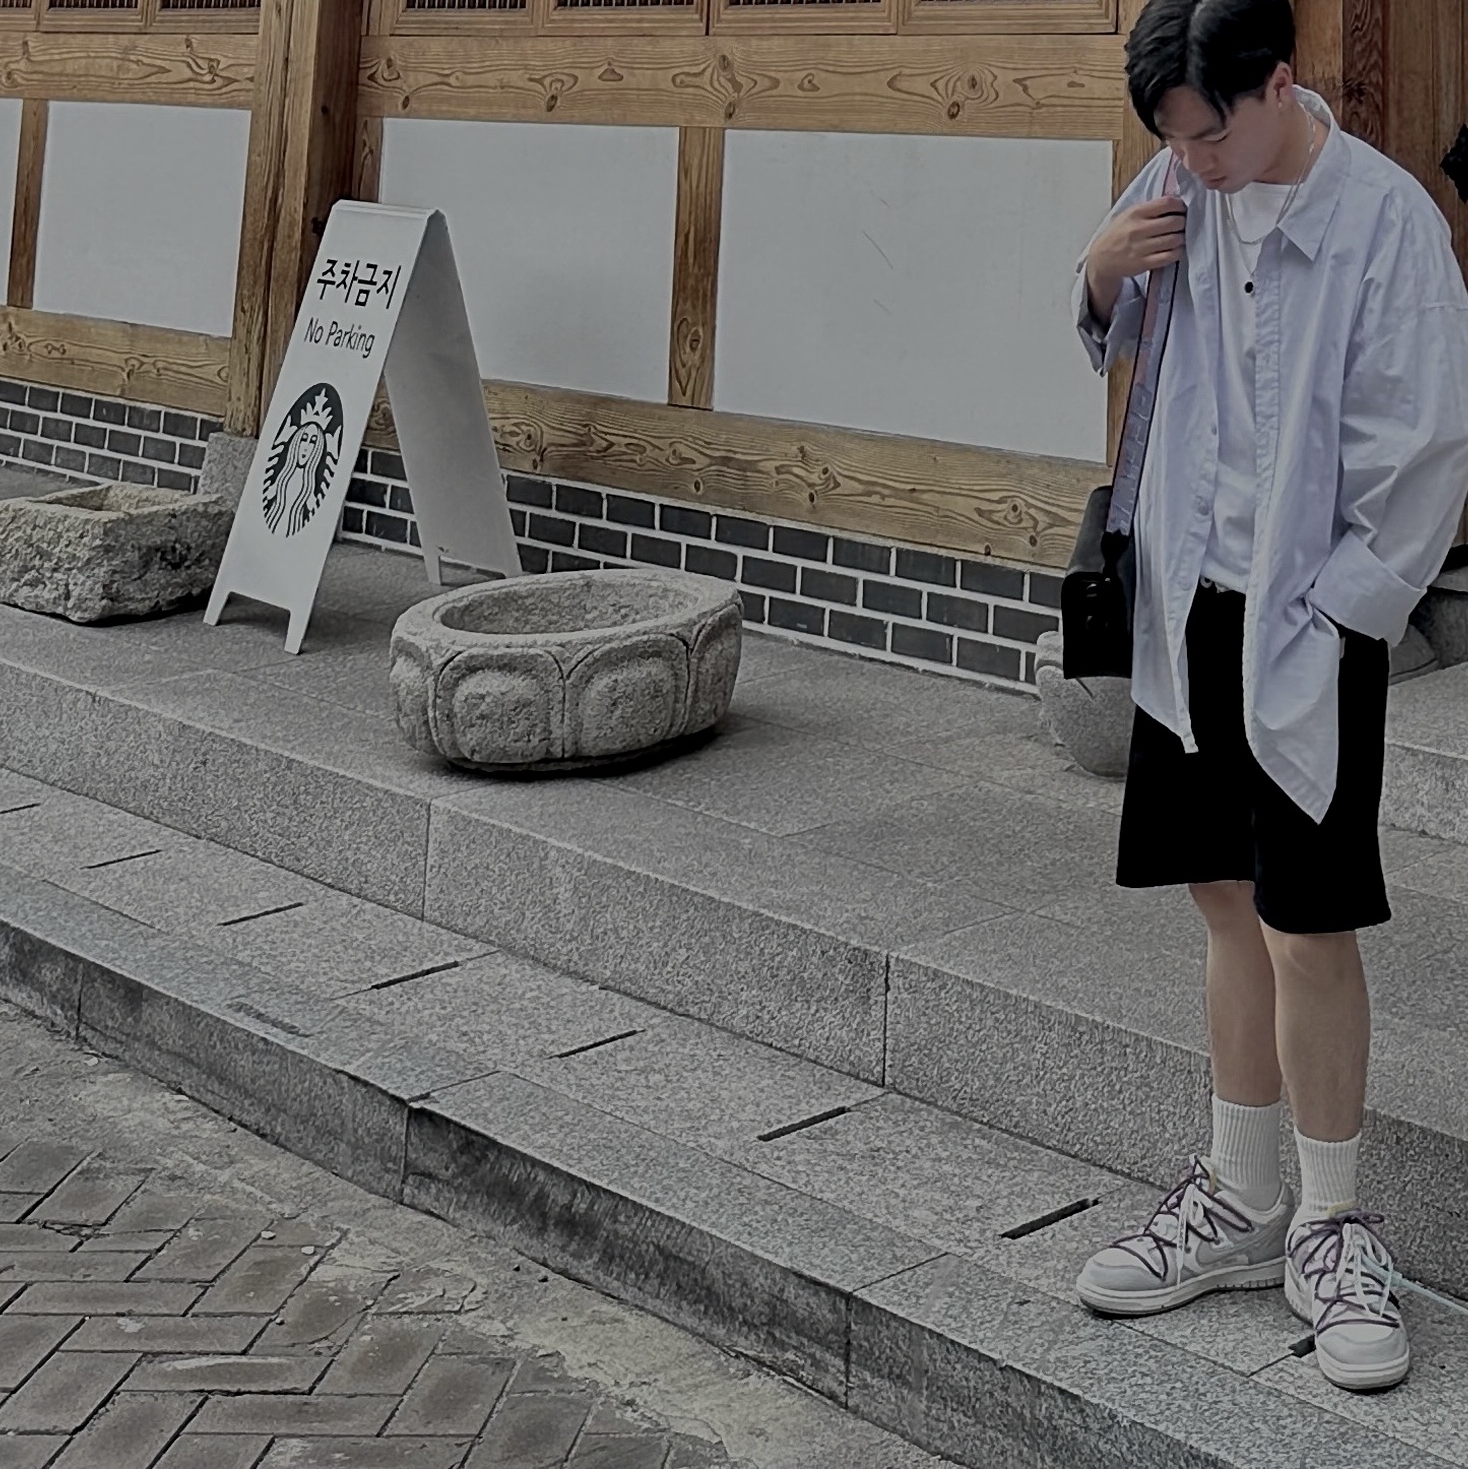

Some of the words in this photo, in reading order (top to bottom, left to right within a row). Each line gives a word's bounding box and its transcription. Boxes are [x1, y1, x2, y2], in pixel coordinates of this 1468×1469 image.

[317, 259, 402, 309] 주차금지
[304, 317, 324, 344] No
[325, 320, 376, 358] Parking
